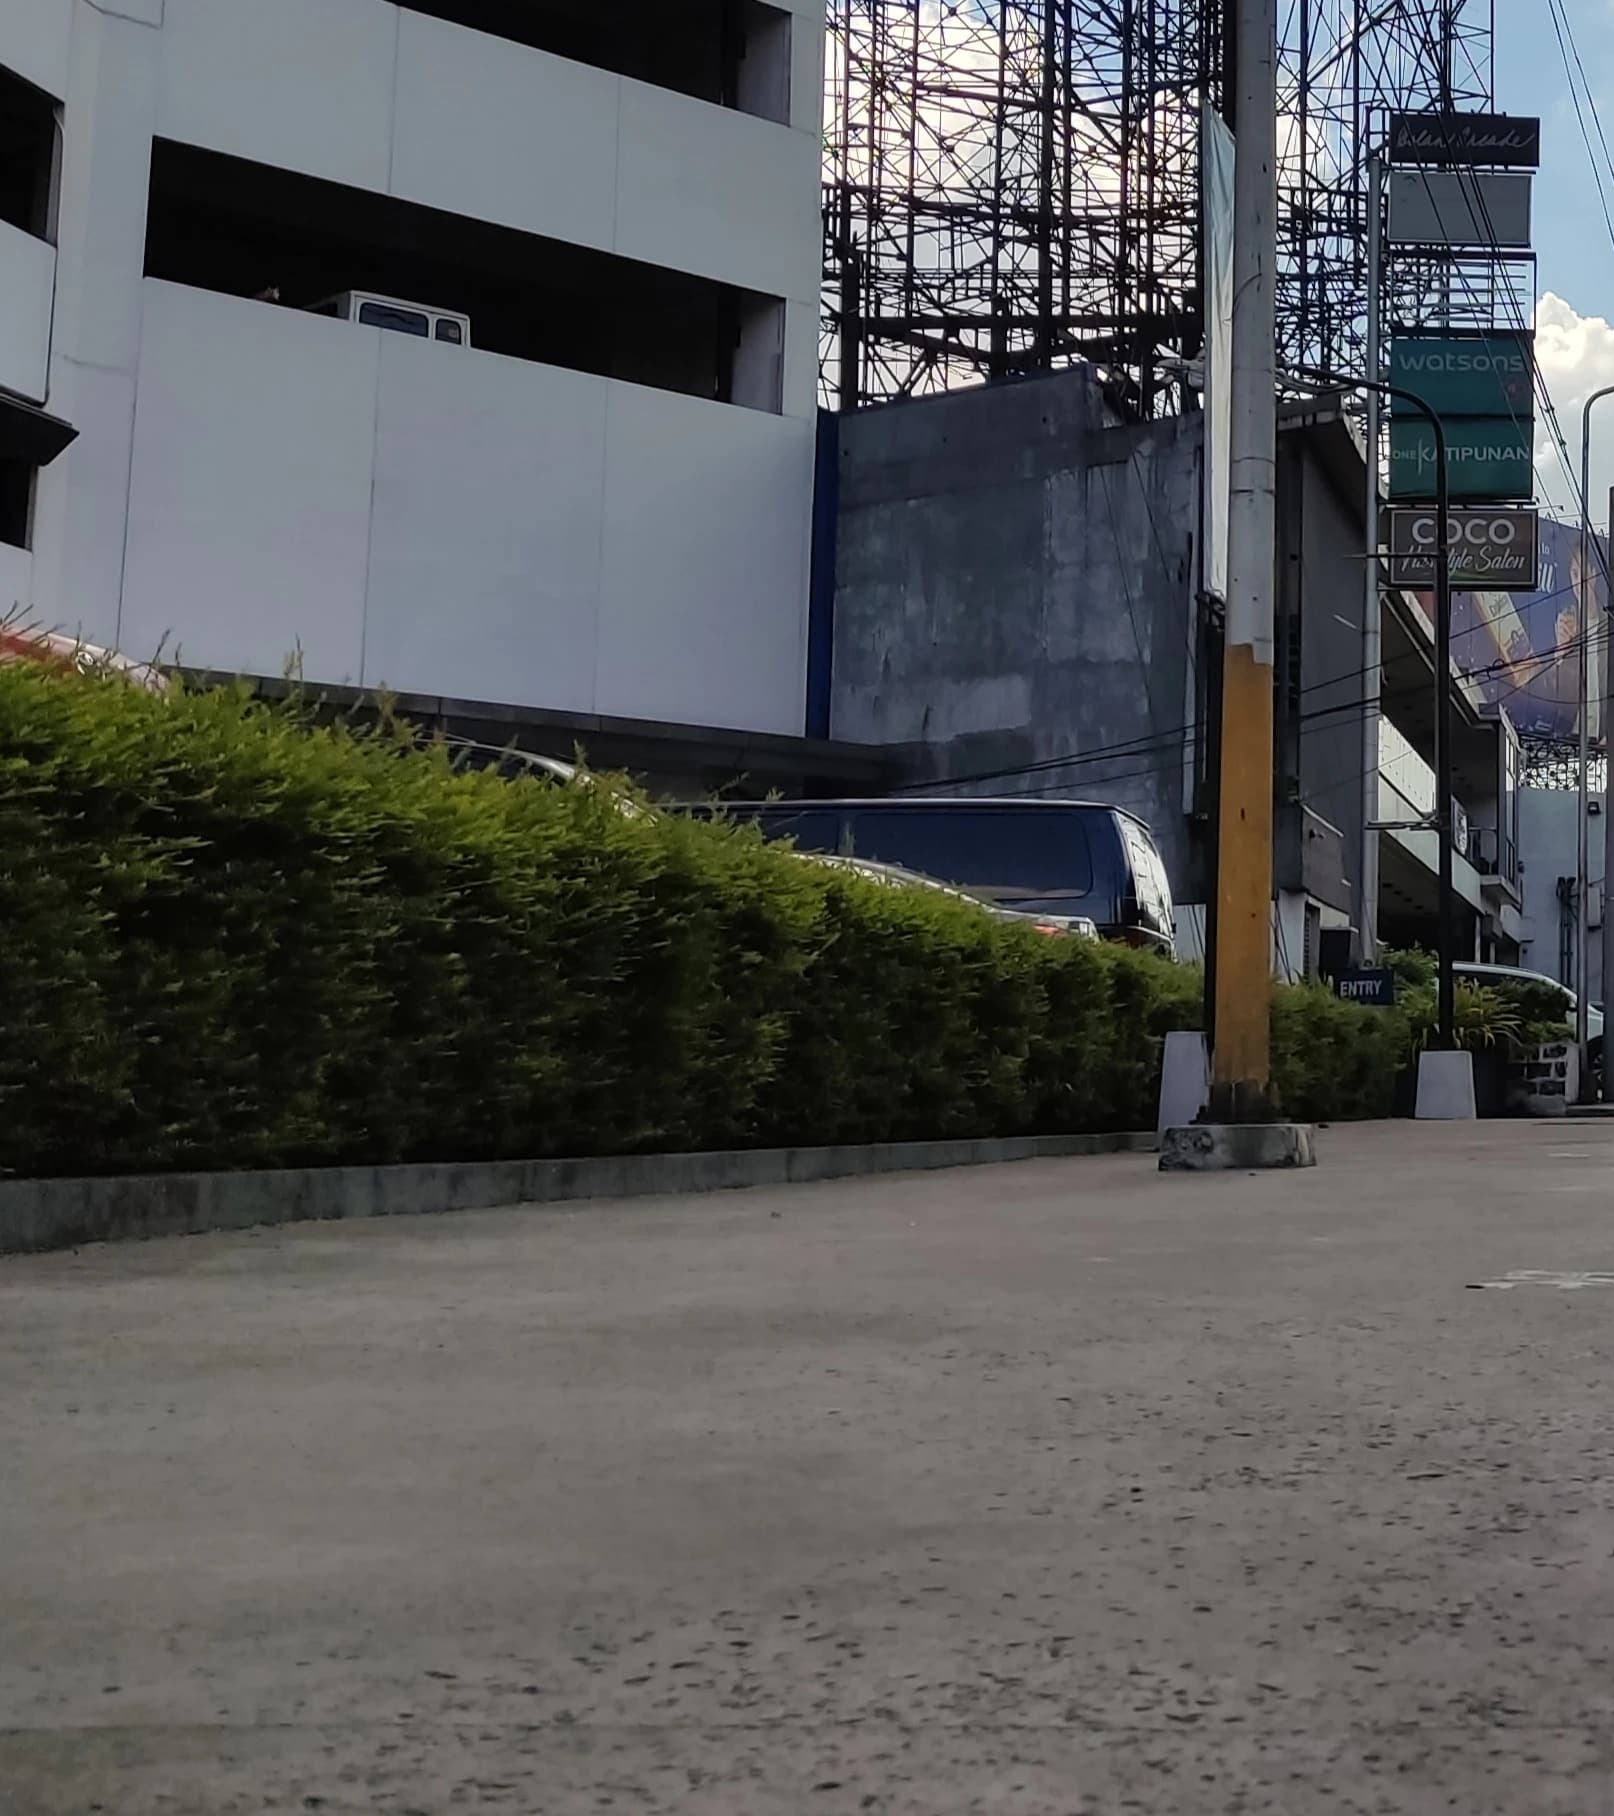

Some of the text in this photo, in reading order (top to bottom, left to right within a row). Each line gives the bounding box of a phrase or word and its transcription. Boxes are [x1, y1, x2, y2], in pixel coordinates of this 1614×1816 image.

[1399, 352, 1524, 372] watsons
[1411, 517, 1515, 545] COCO
[1475, 545, 1525, 572] Salon
[1340, 979, 1382, 997] ENTRY
